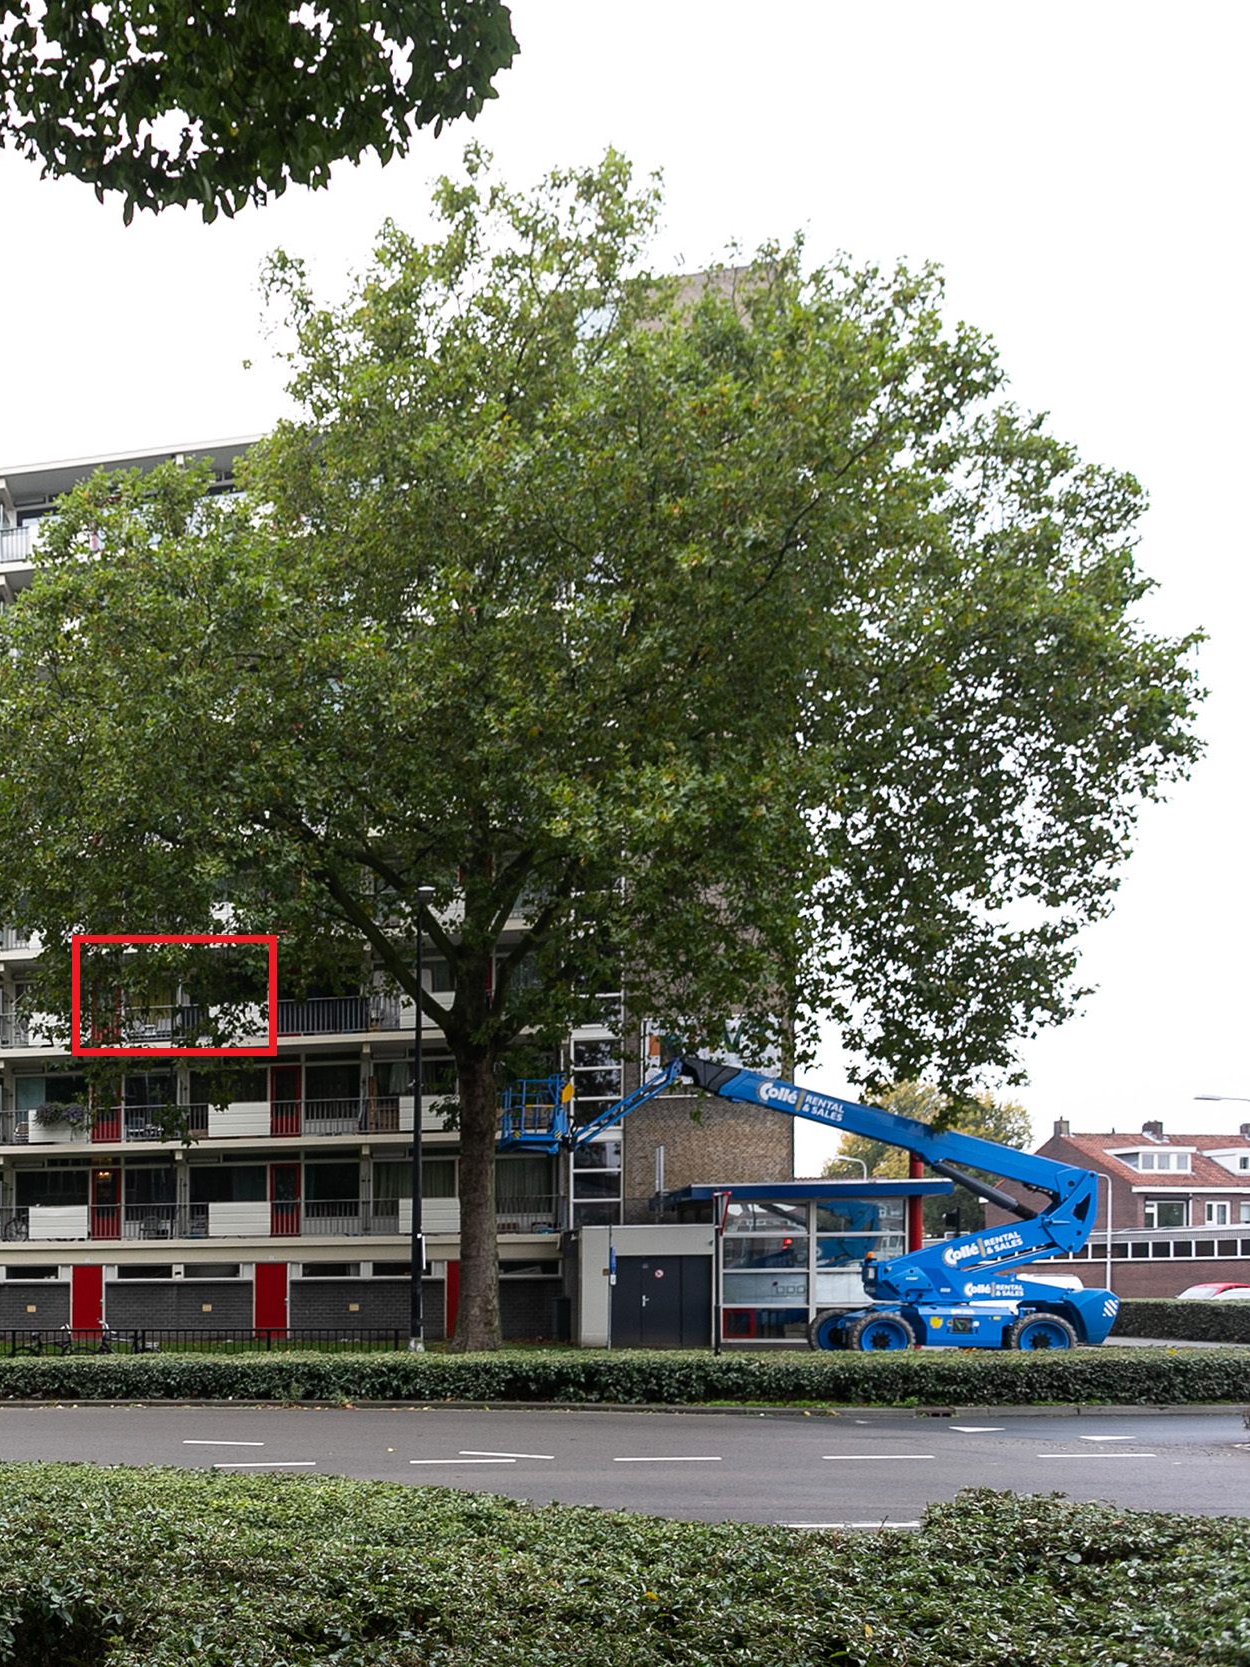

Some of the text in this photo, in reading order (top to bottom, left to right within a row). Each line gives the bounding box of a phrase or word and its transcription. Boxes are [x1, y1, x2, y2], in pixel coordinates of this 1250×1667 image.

[759, 1082, 798, 1104] Collé
[802, 1103, 844, 1122] & SALES
[805, 1094, 845, 1113] RENTAL
[983, 1231, 1021, 1247] RENTAL
[986, 1238, 1024, 1255] & SALES
[944, 1242, 980, 1265] Collé
[964, 1282, 991, 1297] Collé
